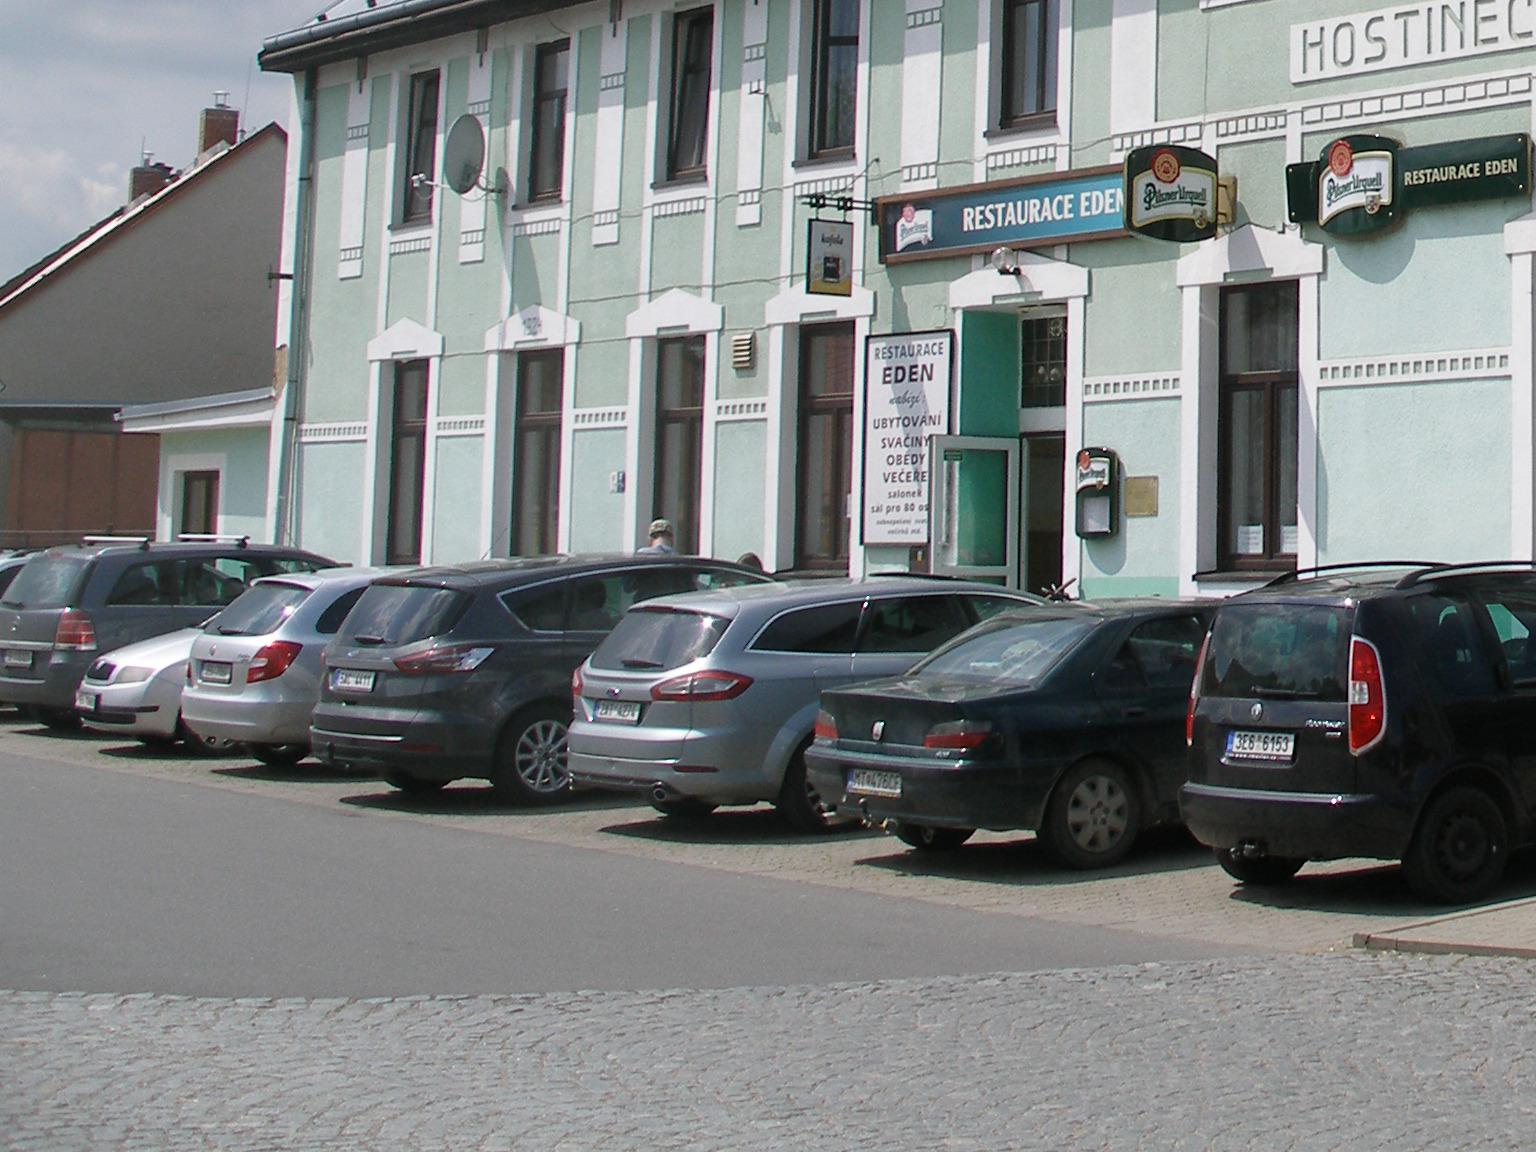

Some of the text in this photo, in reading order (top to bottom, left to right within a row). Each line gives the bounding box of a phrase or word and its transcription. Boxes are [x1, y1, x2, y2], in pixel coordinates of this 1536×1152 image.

[1403, 158, 1518, 185] RESTAURACE EDEN
[963, 195, 1073, 232] RESTAURACE
[874, 341, 944, 360] RESTAURACE
[882, 363, 934, 384] EDEN
[873, 410, 942, 429] UBYTOVÁNÍ
[881, 434, 929, 449] SVAČINY
[888, 489, 922, 499] salonek
[871, 504, 883, 514] sál
[886, 505, 900, 515] pro
[903, 502, 915, 512] 80
[1235, 734, 1289, 752] 3E6 6153
